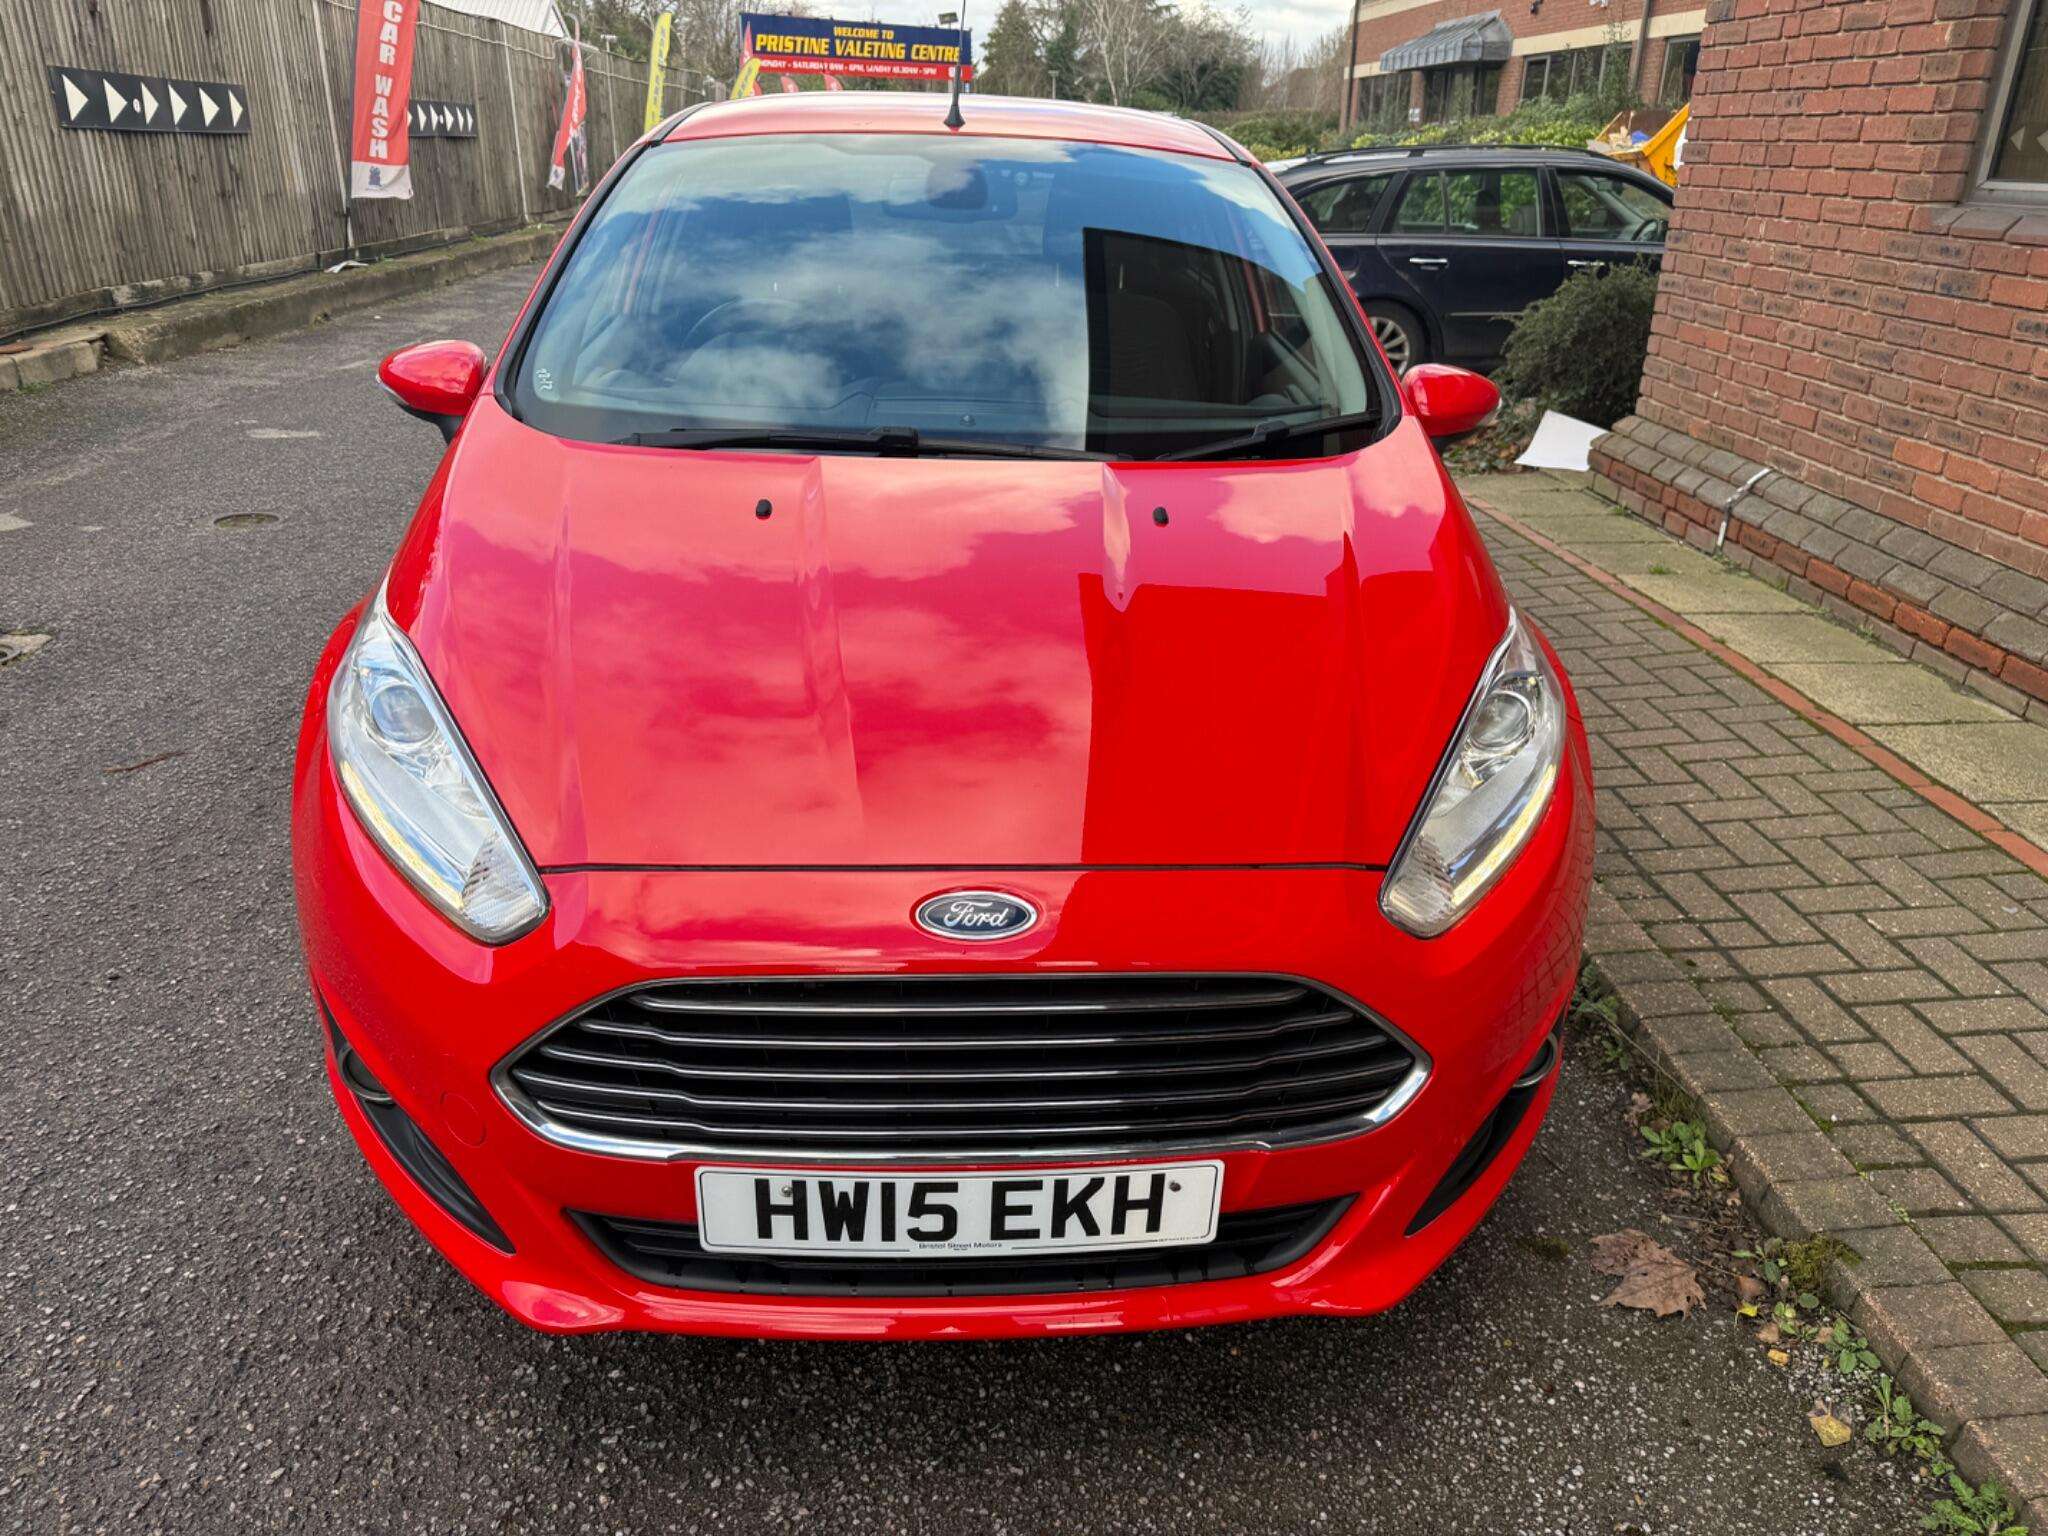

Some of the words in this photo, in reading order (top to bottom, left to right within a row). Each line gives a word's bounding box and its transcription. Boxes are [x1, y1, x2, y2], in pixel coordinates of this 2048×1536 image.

[379, 0, 403, 66] CAR
[834, 26, 879, 40] WELCOME
[881, 29, 895, 40] TO
[756, 34, 829, 56] PRISTINE
[835, 39, 906, 60] VALETING
[911, 44, 960, 63] CENTRE
[792, 61, 828, 71] SATURDAY
[368, 73, 394, 160] WASH
[943, 901, 1009, 927] Ford
[753, 1177, 958, 1242] HW15
[990, 1173, 1167, 1240] EKH
[919, 1242, 946, 1250] Bristol
[974, 1241, 1003, 1249] Motors
